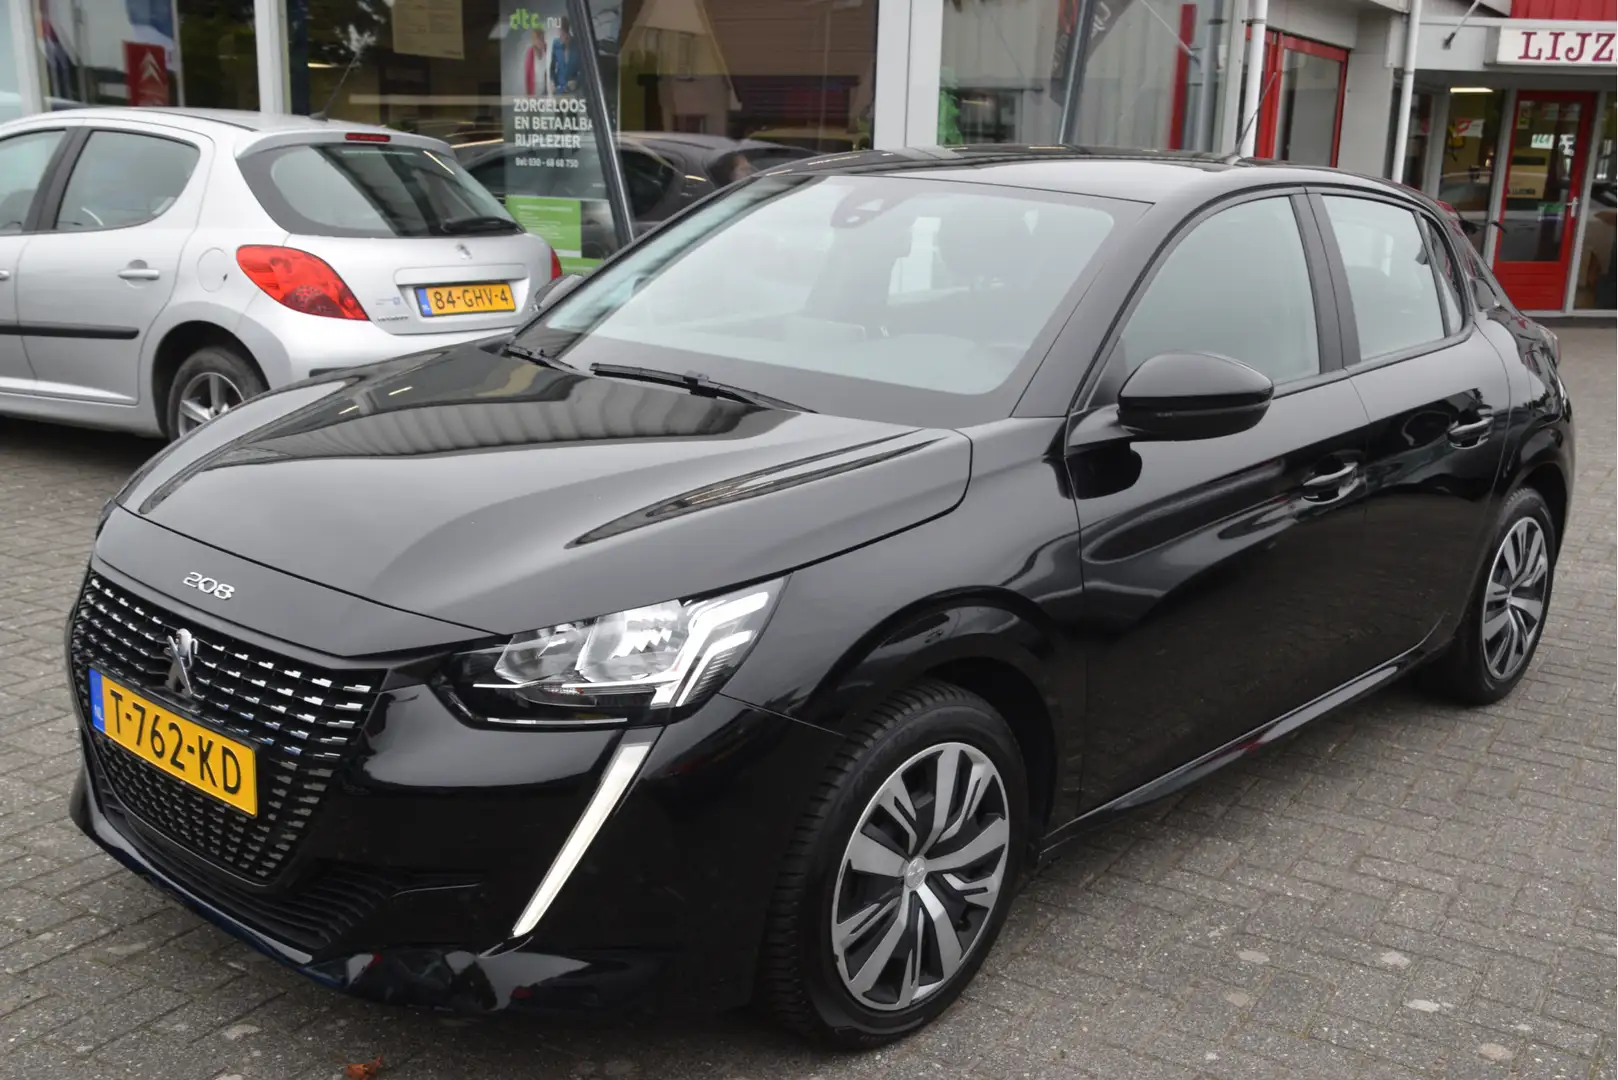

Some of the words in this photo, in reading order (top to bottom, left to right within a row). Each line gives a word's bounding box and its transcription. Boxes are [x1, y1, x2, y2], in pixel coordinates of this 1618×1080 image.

[1517, 31, 1616, 62] LIJZ
[513, 98, 587, 113] ZORGELOOS
[514, 117, 530, 130] EN
[514, 133, 582, 149] RIJPLEZIER
[433, 286, 510, 311] 84-GHV-4
[181, 571, 236, 601] 208
[109, 687, 242, 796] T-762-KD
